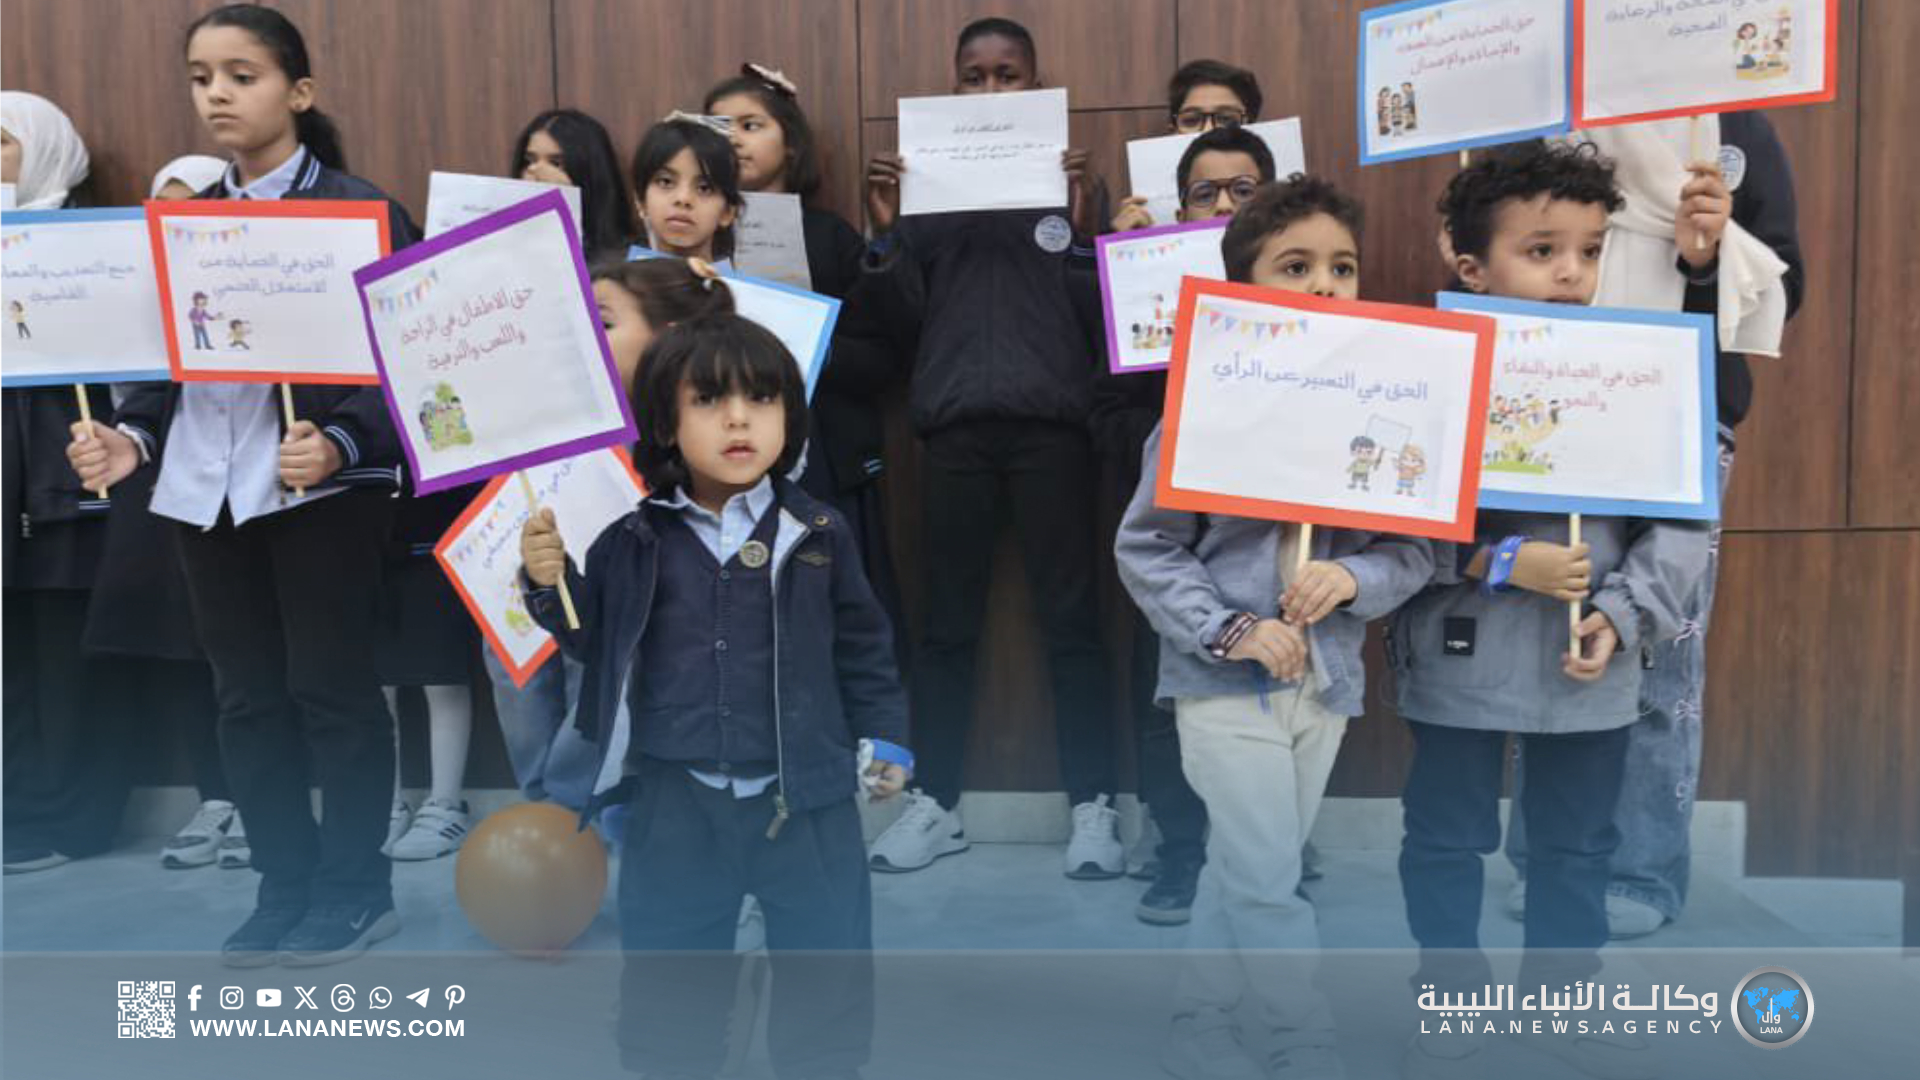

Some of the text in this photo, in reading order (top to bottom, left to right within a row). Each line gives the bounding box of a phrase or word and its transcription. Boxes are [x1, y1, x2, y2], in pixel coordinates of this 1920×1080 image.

[1301, 368, 1356, 395] التعبير
[1356, 381, 1383, 405] في
[1385, 380, 1429, 403] الحق
